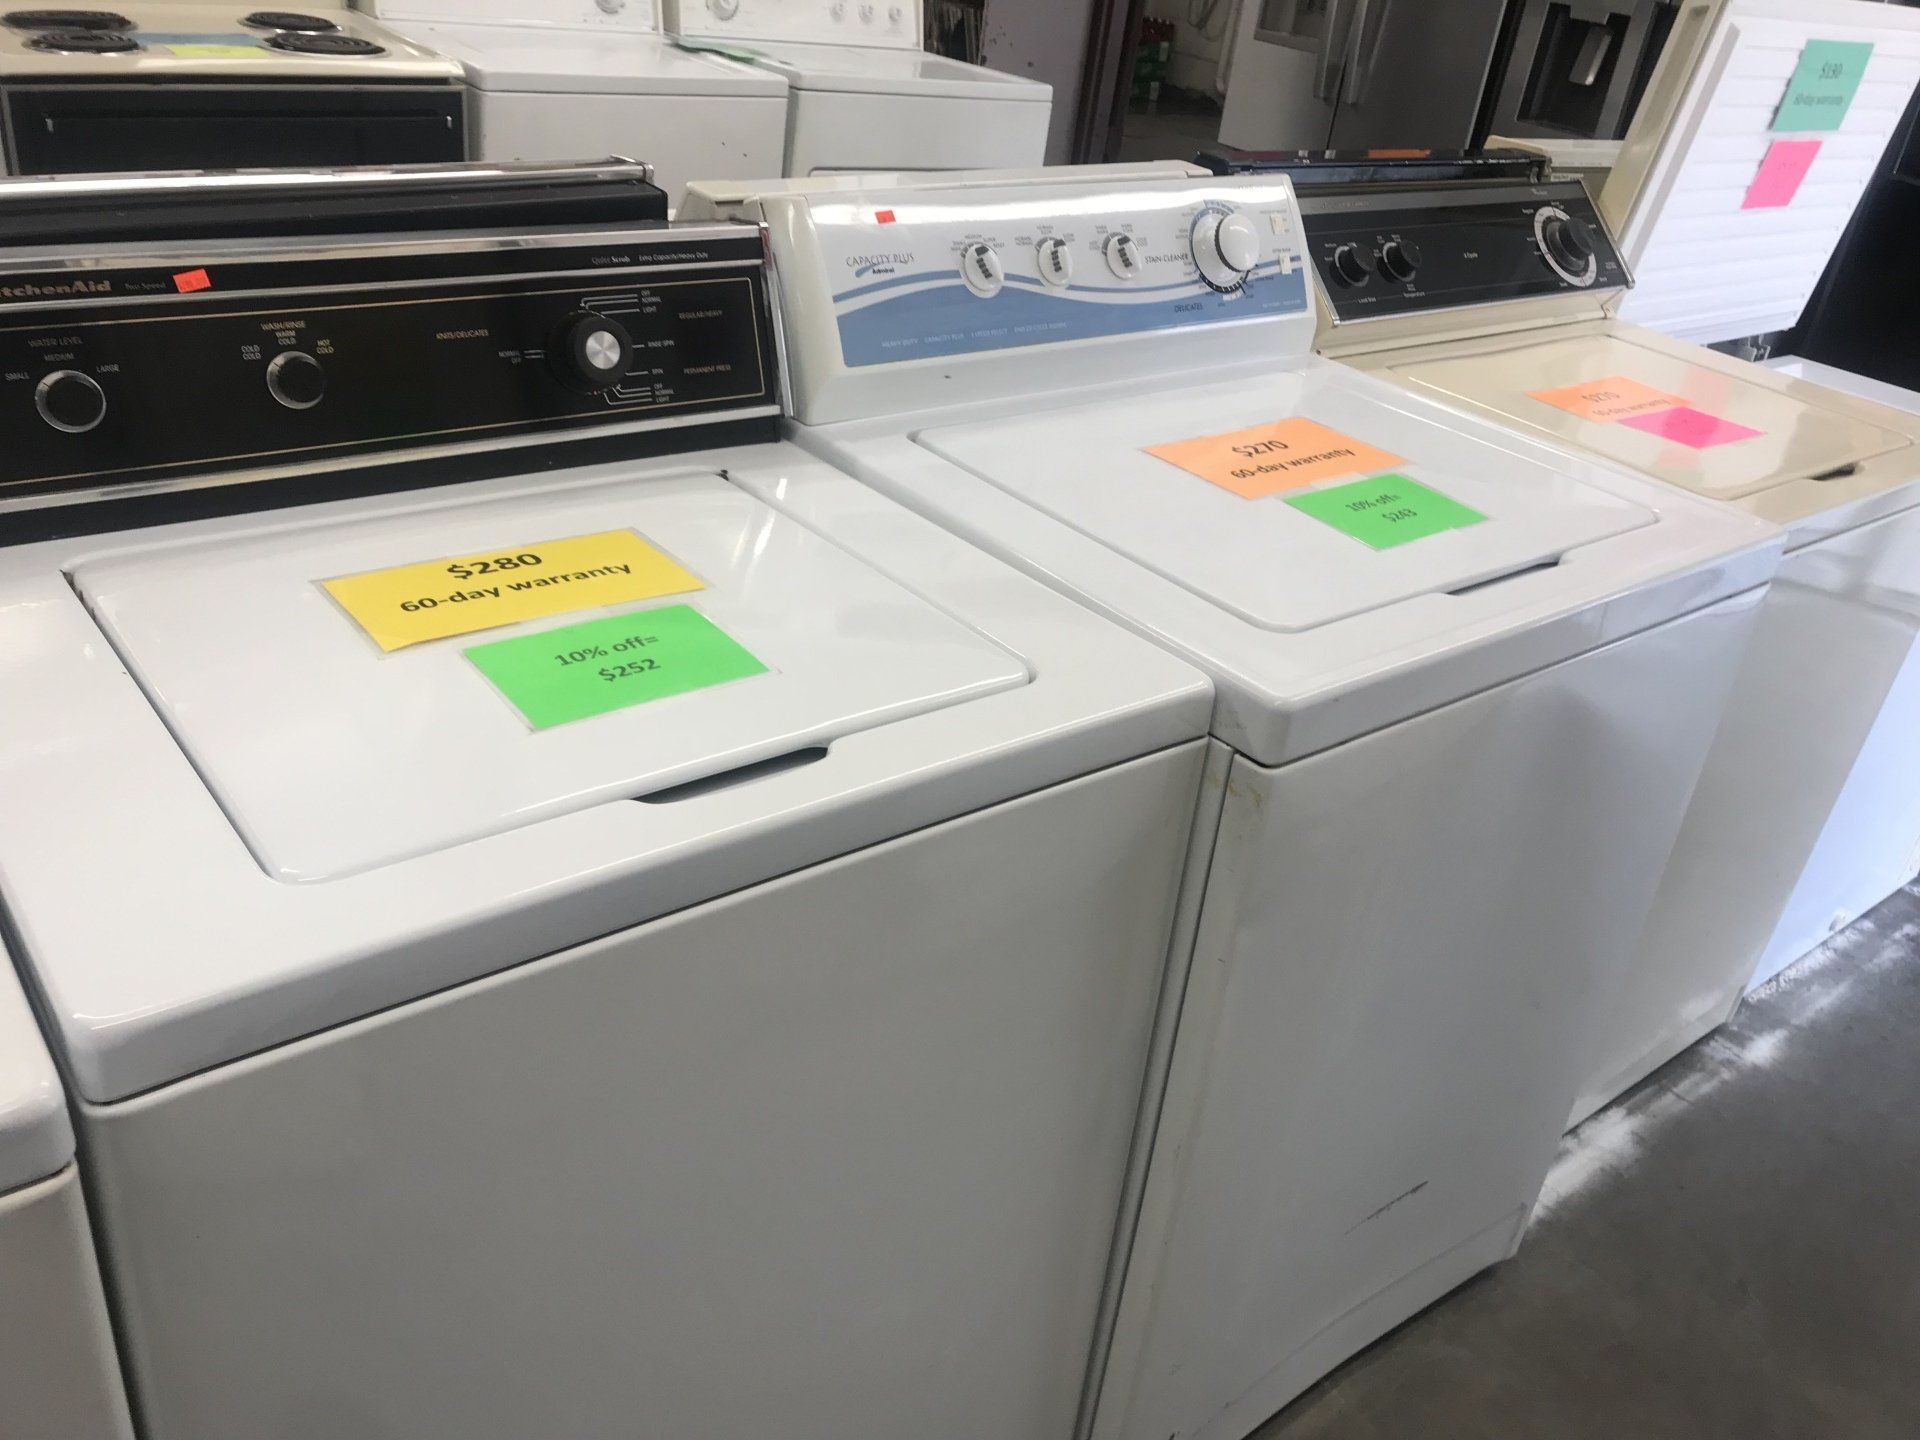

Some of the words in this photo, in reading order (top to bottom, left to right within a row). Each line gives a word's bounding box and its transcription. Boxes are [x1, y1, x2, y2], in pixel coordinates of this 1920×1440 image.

[846, 254, 891, 267] CAPACITY
[894, 252, 914, 264] PLUS
[0, 280, 112, 298] tchenAid
[1232, 439, 1289, 458] $270
[1230, 462, 1289, 480] 60-day
[1287, 448, 1355, 470] warranty
[1345, 496, 1375, 512] 10%
[1383, 508, 1418, 523] $243
[447, 552, 543, 580] $280
[400, 585, 501, 613] 60-day
[506, 563, 632, 592] warranty
[554, 645, 607, 667] 10%
[613, 634, 659, 653] off=
[598, 657, 662, 683] $252
